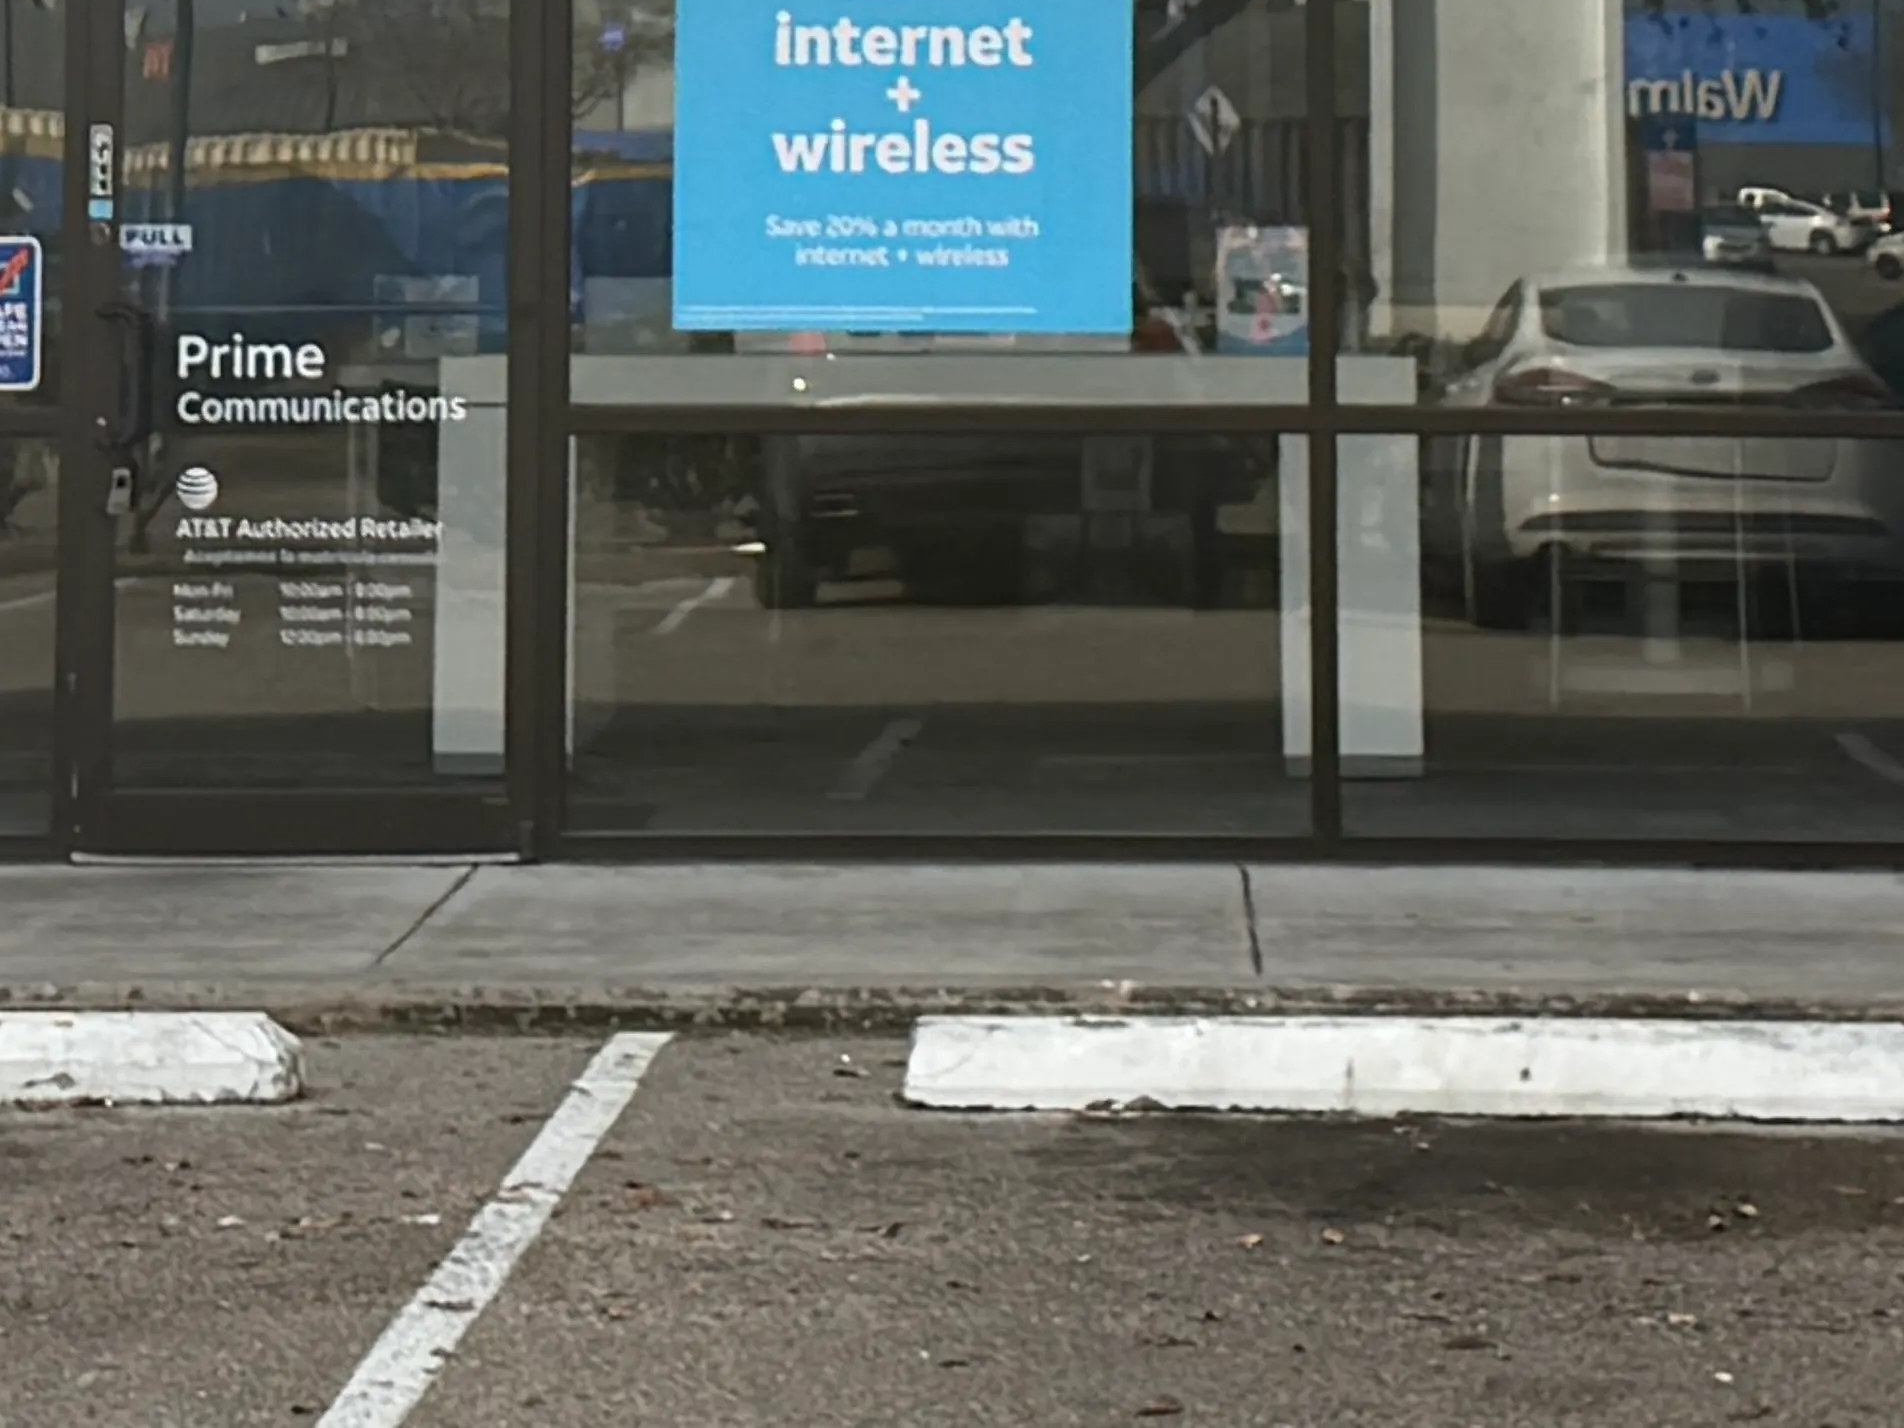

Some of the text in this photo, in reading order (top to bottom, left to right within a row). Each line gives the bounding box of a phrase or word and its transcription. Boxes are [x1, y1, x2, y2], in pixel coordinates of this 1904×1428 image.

[775, 11, 1032, 66] internet
[773, 119, 1034, 173] wireless
[125, 229, 184, 244] PULL
[765, 214, 1039, 237] Save 20% a month with
[795, 245, 889, 266] internet
[916, 244, 1009, 266] wireless
[177, 333, 325, 379] Prime
[177, 390, 467, 424] Communications
[176, 517, 444, 539] AT&T Authorized Retailer
